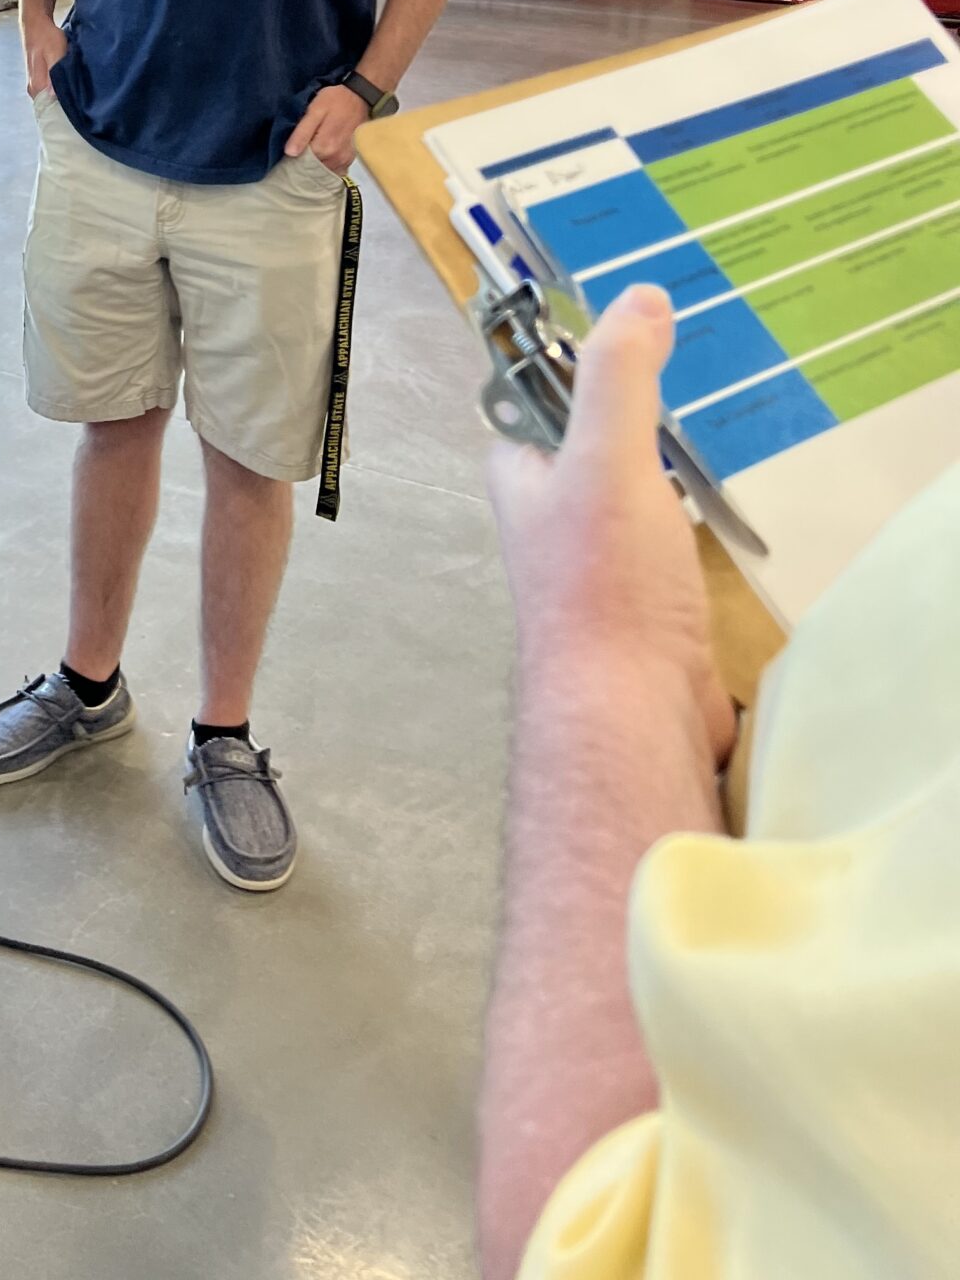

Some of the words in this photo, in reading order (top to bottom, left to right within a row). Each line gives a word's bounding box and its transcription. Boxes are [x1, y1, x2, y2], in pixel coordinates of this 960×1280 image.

[348, 188, 361, 243] APPALACHI
[342, 267, 355, 298] STATE
[338, 300, 351, 367] APPALACHIAN
[332, 392, 345, 422] STATE
[325, 423, 341, 490] APPALACHIAN
